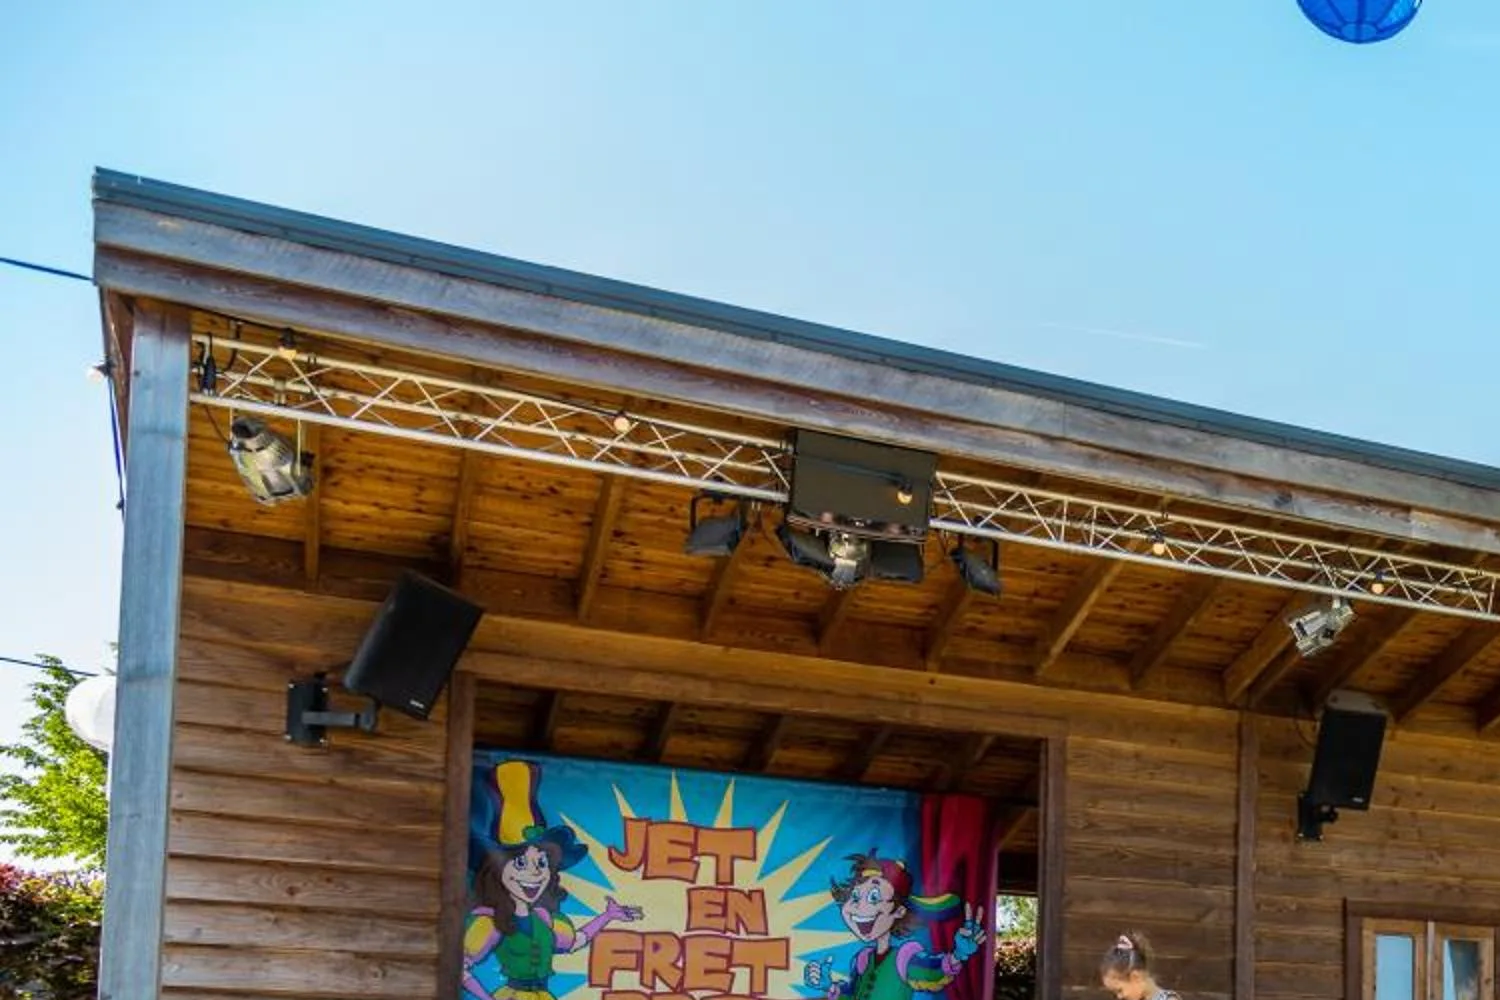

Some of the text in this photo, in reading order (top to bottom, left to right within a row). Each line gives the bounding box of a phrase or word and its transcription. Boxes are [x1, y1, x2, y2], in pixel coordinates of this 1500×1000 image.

[608, 818, 757, 885] JET
[686, 887, 768, 936] EN
[589, 930, 791, 995] FRET
